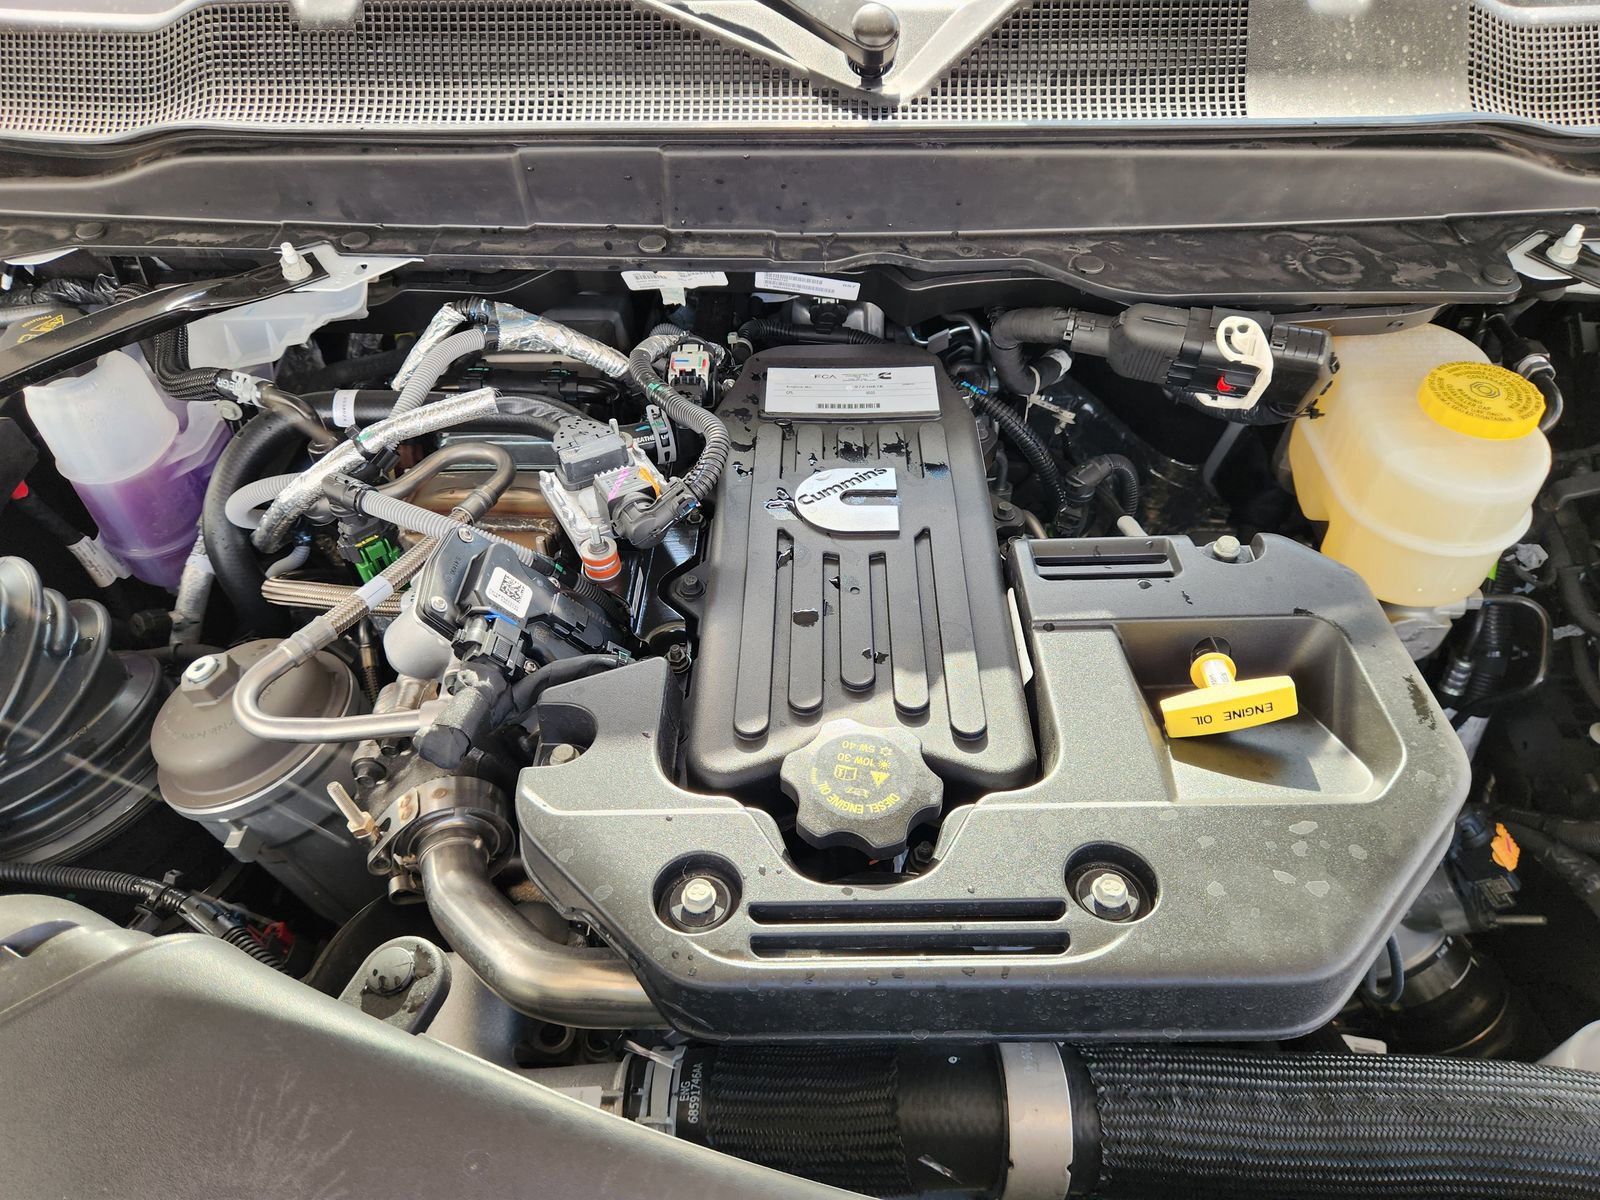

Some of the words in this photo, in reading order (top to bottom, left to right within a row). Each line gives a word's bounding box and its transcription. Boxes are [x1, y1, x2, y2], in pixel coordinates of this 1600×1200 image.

[798, 468, 887, 505] Cummins
[1191, 714, 1213, 725] OIL
[1223, 702, 1274, 721] ENGINE
[841, 740, 876, 754] 5W-40
[837, 752, 875, 767] 10W-30
[817, 781, 832, 795] OIL
[826, 793, 864, 814] ENGINE
[866, 793, 900, 814] DIESEL
[679, 1081, 691, 1102] ENG
